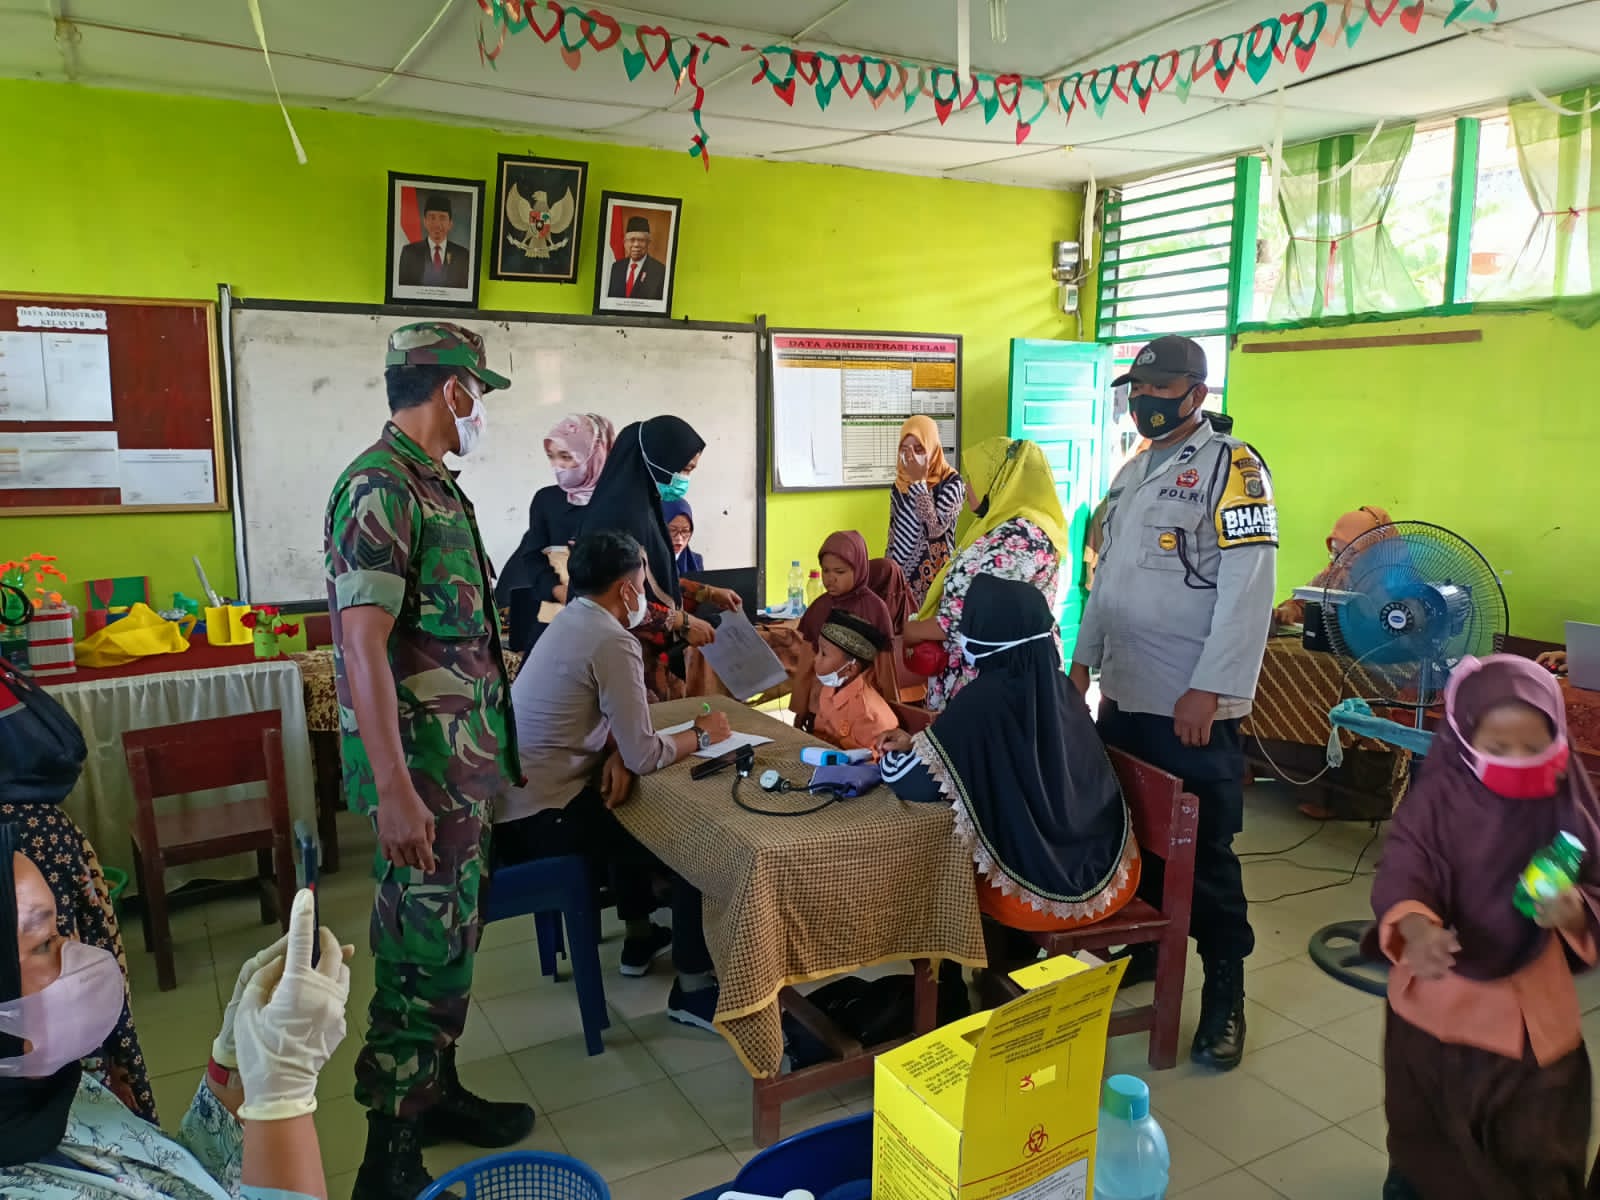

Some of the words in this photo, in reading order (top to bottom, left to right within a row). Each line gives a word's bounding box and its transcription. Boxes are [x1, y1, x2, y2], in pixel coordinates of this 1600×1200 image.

[46, 311, 104, 319] ADMINISTRASI
[788, 340, 822, 348] DATA
[825, 340, 908, 350] ADMINISTRASI
[911, 343, 947, 351] KELAS
[1159, 488, 1205, 503] POLRI
